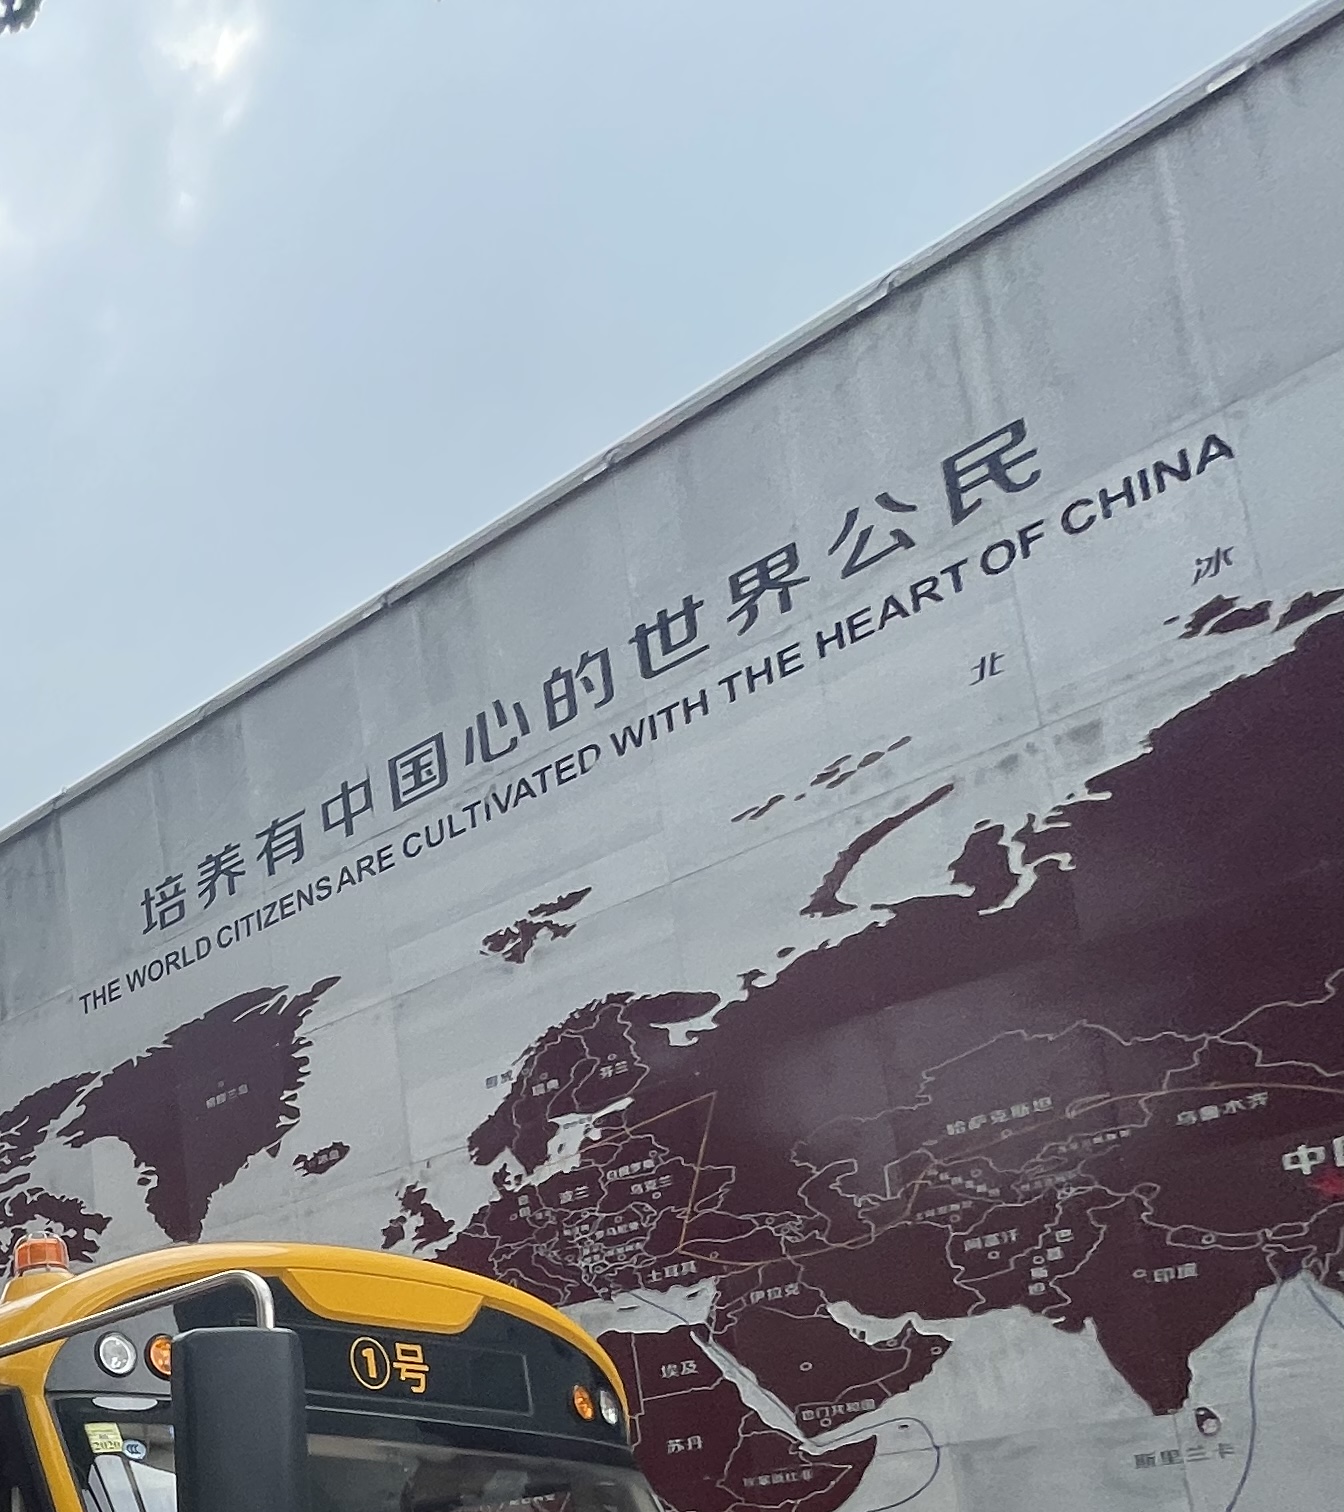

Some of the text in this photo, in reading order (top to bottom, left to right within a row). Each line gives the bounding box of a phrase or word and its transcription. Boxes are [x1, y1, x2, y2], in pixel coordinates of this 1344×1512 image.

[79, 433, 1235, 1015] THE WORLD CITIZENS ARE CULTIVATED WITH THE HEART OF CHINA
[140, 417, 1041, 936] 培养有中国心的世界公民
[969, 651, 1006, 686] 北
